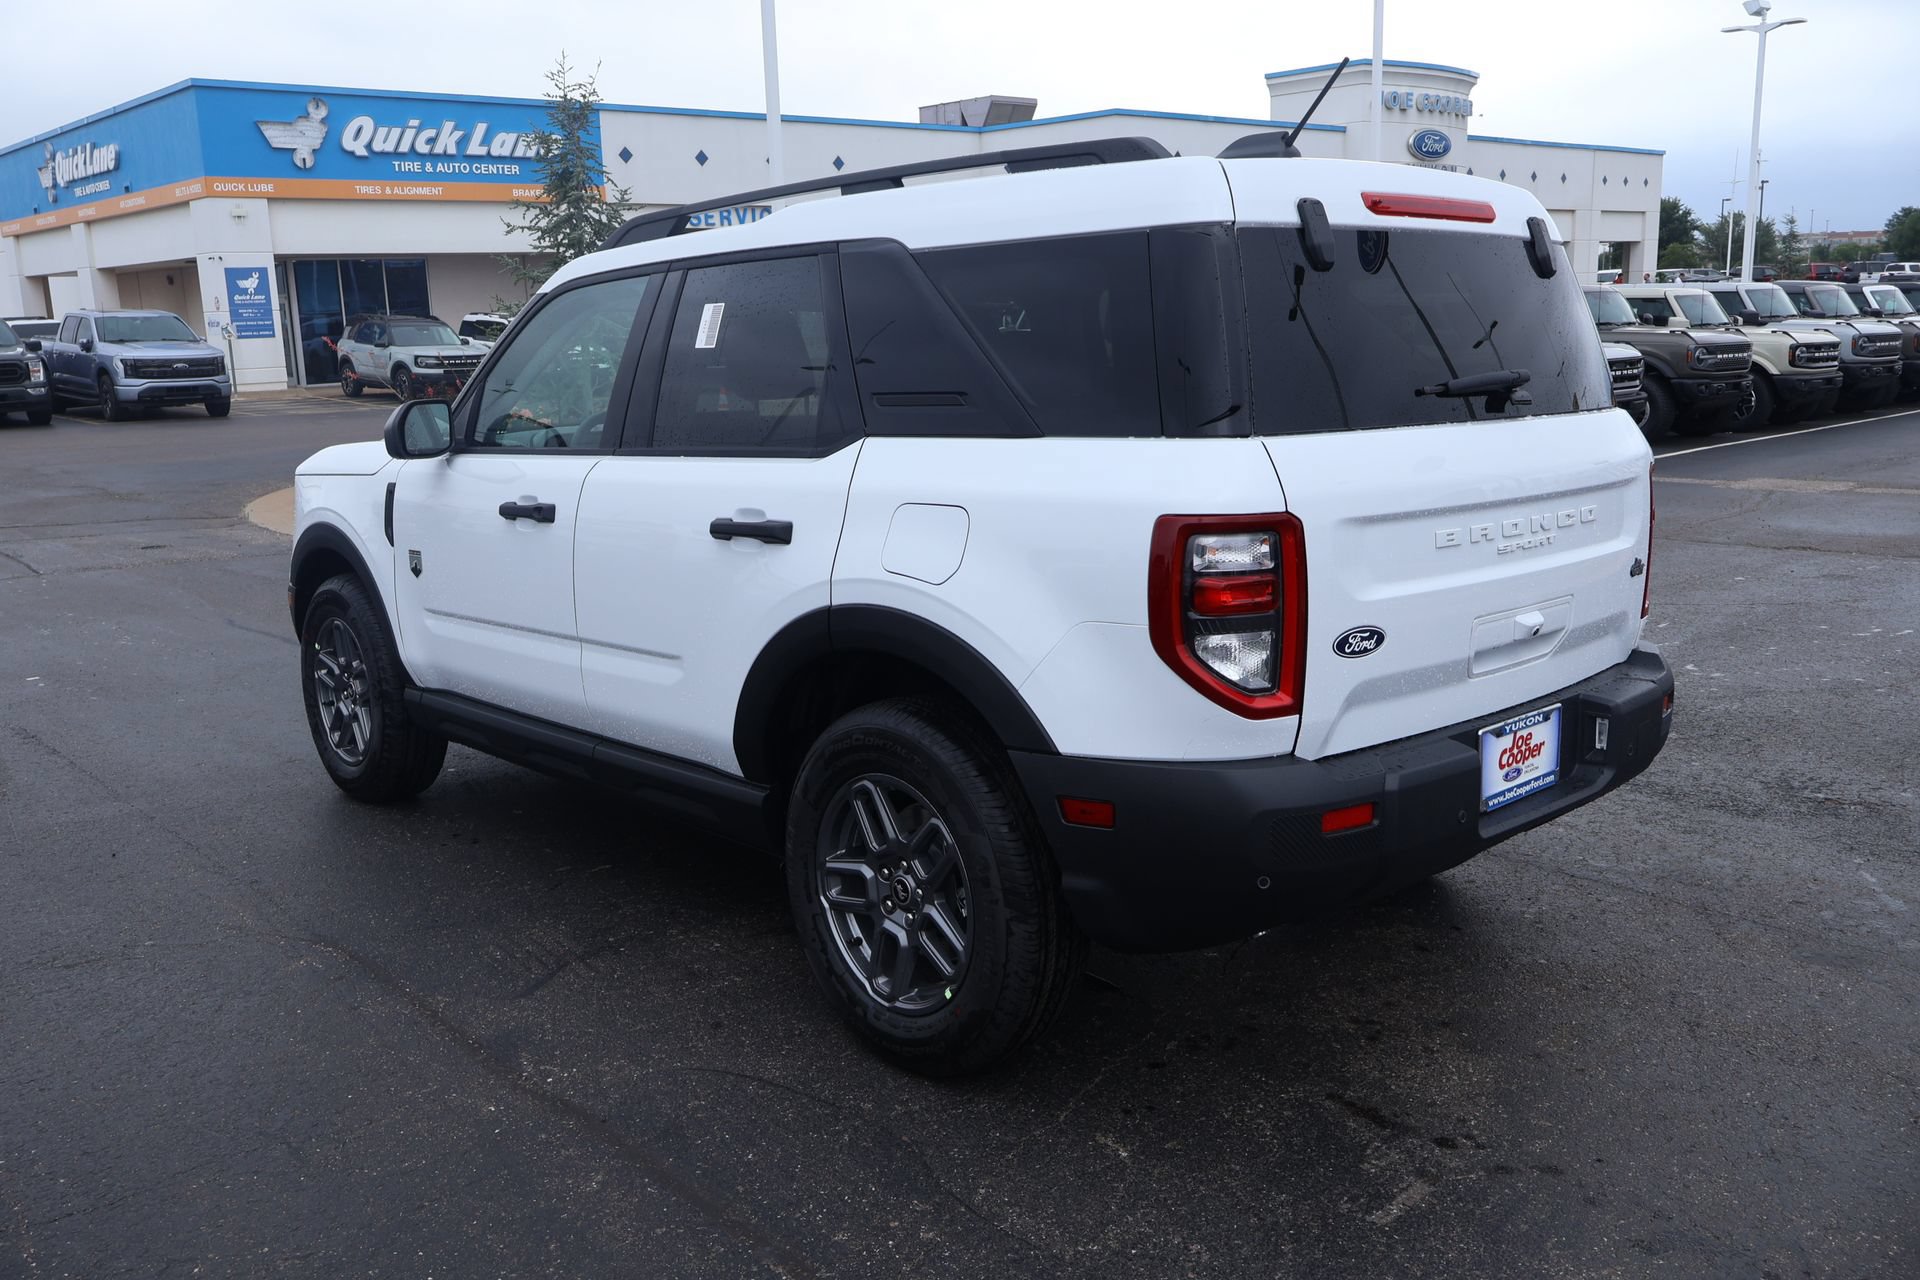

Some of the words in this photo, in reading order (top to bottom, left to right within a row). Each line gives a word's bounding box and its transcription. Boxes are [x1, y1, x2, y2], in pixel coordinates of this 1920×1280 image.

[340, 115, 465, 157] Quick
[55, 145, 86, 187] Quick
[85, 142, 117, 175] Lane
[392, 161, 422, 173] TIRE
[425, 162, 434, 173] &
[436, 162, 470, 174] AUTO
[472, 163, 520, 175] CENTER
[213, 182, 246, 192] QUICK
[248, 183, 274, 192] LUBE
[355, 185, 382, 195] TIRES
[385, 186, 392, 195] &
[393, 186, 443, 196] ALIGNMENT
[1435, 505, 1597, 548] BRONCO
[1497, 533, 1558, 555] SPORT
[1344, 631, 1378, 653] Ford
[1505, 714, 1543, 733] YUKON
[1508, 731, 1533, 753] Joe
[1498, 740, 1545, 771] Cooper
